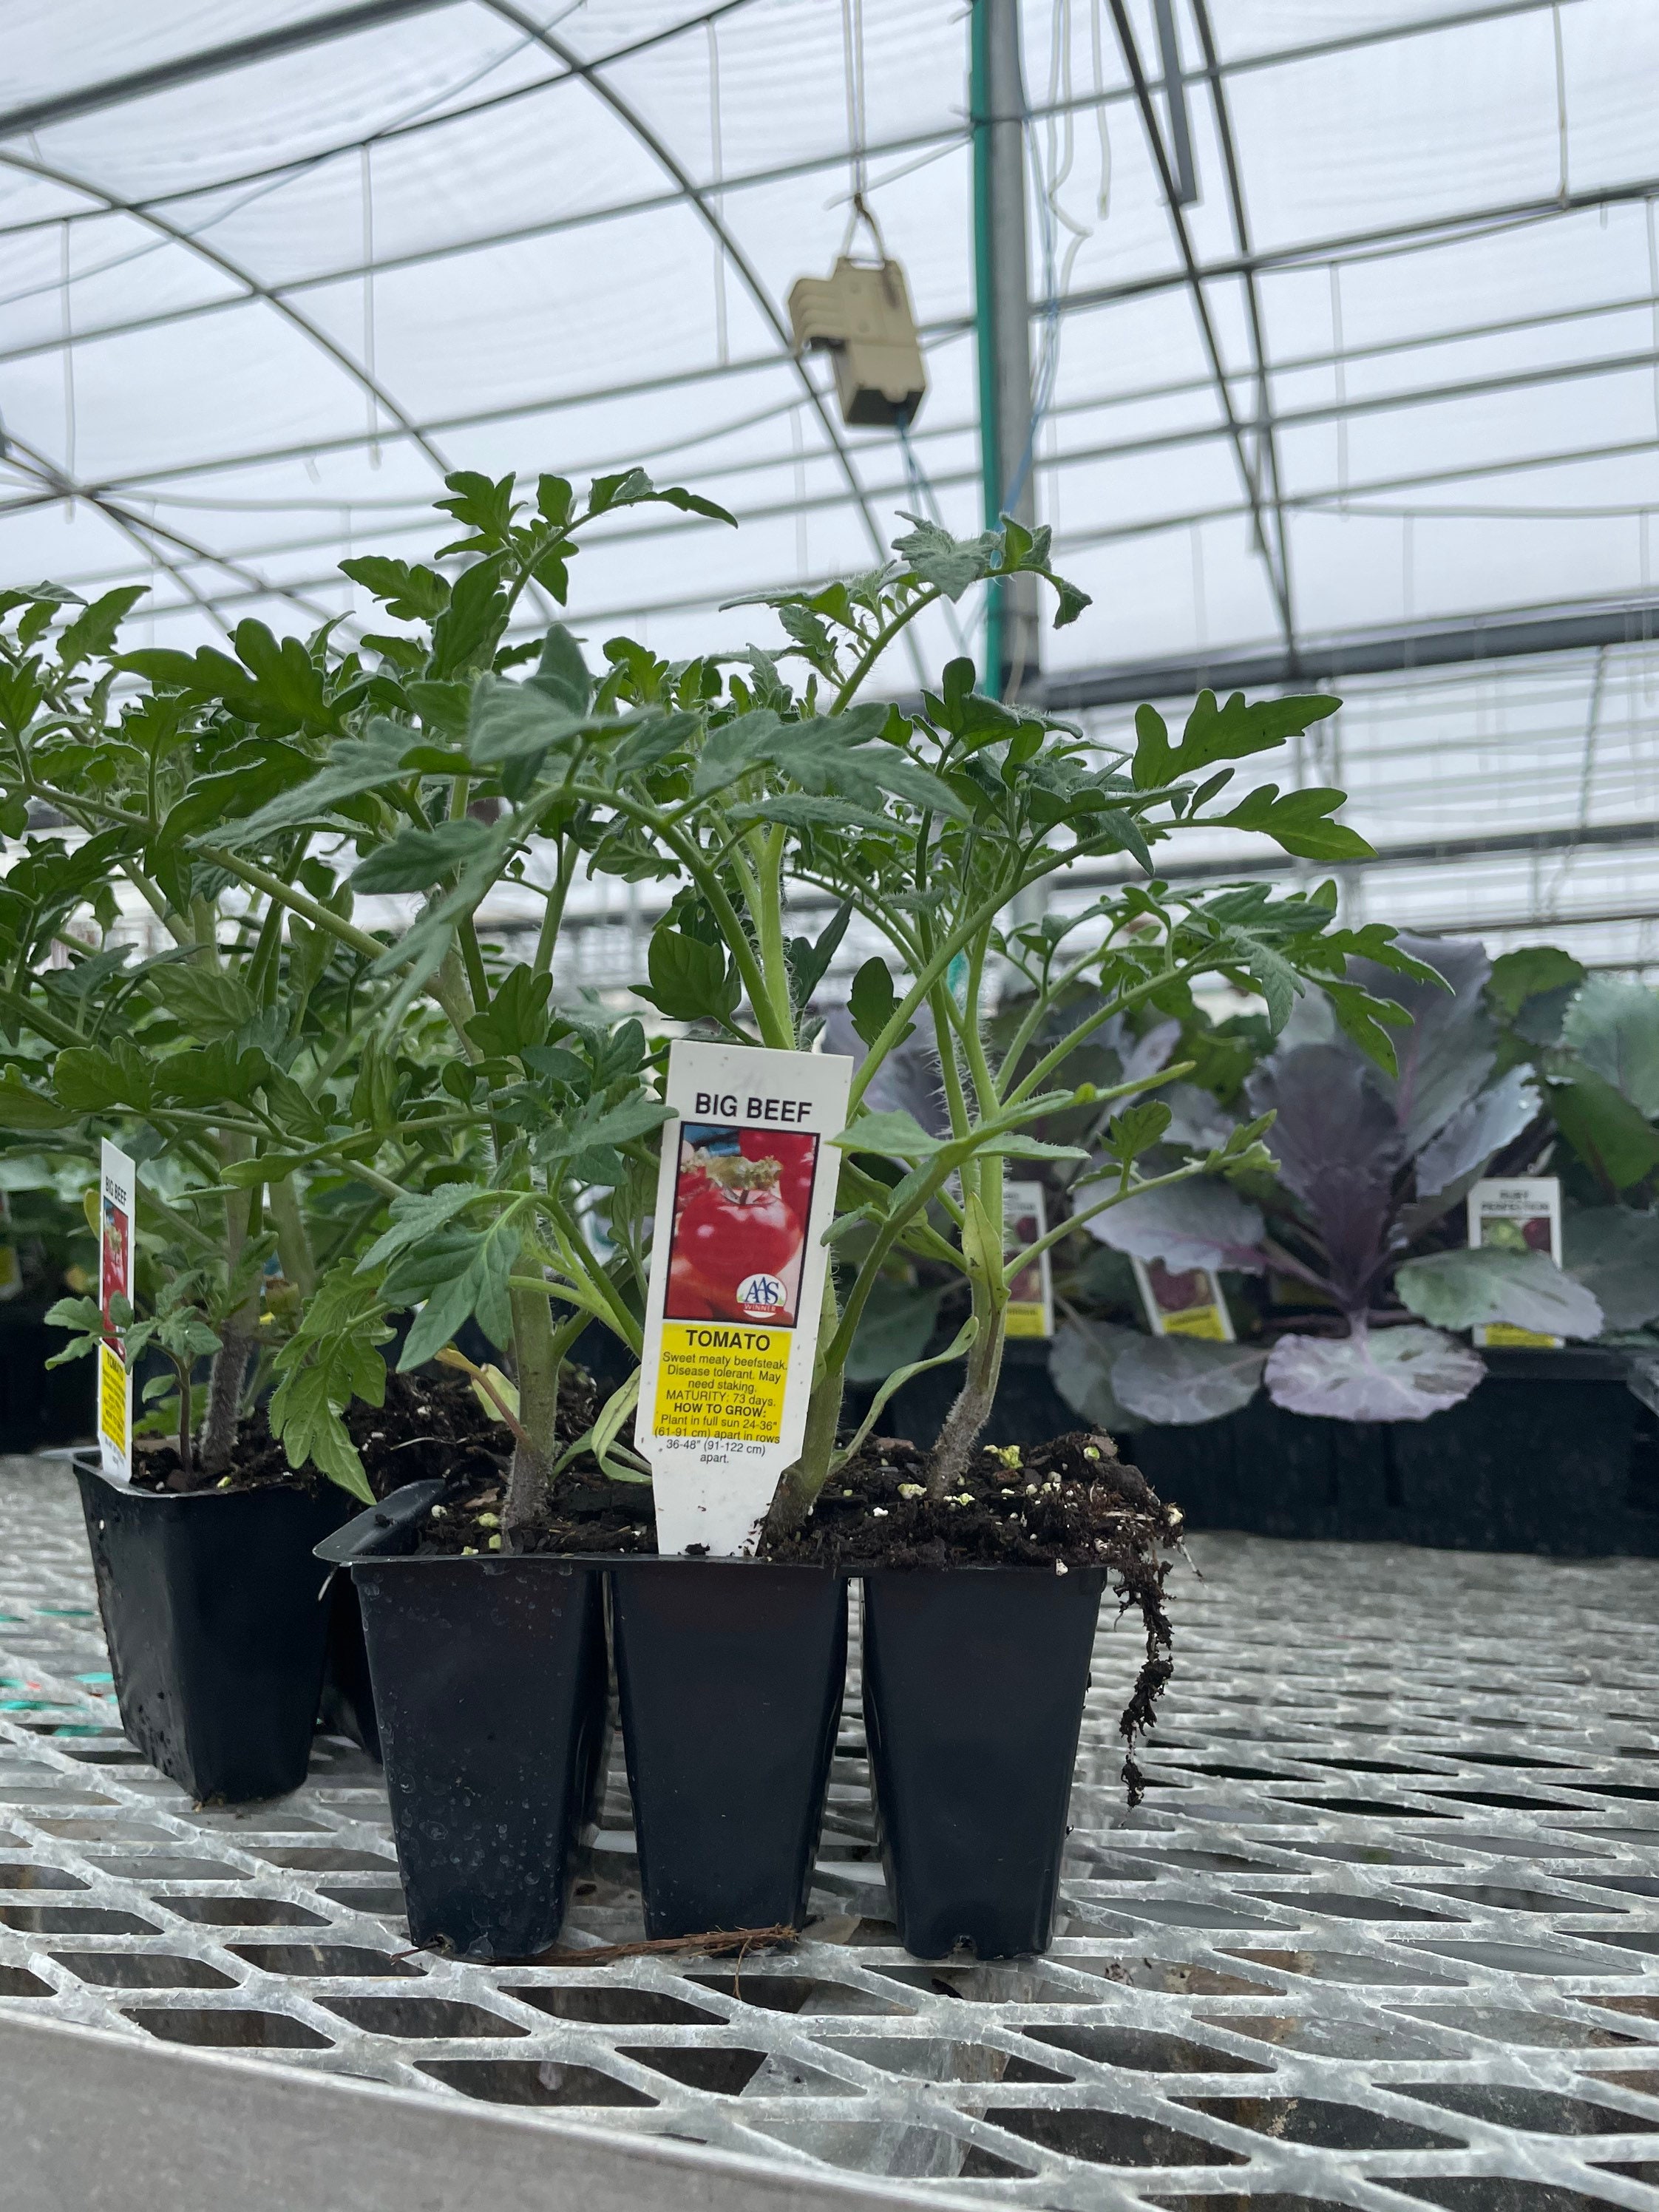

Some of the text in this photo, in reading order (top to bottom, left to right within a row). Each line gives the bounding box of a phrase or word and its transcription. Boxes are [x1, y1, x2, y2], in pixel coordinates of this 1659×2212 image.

[695, 1093, 812, 1123] BIG BEEF
[106, 1175, 126, 1207] BIG BEEF
[744, 1277, 779, 1305] AAS
[744, 1303, 776, 1312] WINNER
[686, 1329, 770, 1351] TOMATO
[662, 1351, 787, 1370] Sweet meaty beefsteak.
[668, 1364, 781, 1385] Disease tolerant. May
[688, 1380, 757, 1394] need staking.
[666, 1390, 776, 1408] MATURITY: 73 days.
[674, 1402, 766, 1418] HOW TO GROW:
[661, 1414, 777, 1431] Plant in full sun 24-36"
[654, 1426, 780, 1444] (61-91 cm) apart in rows
[666, 1439, 766, 1457] 36-48" (91-122 cm)
[700, 1453, 729, 1465] apart.
